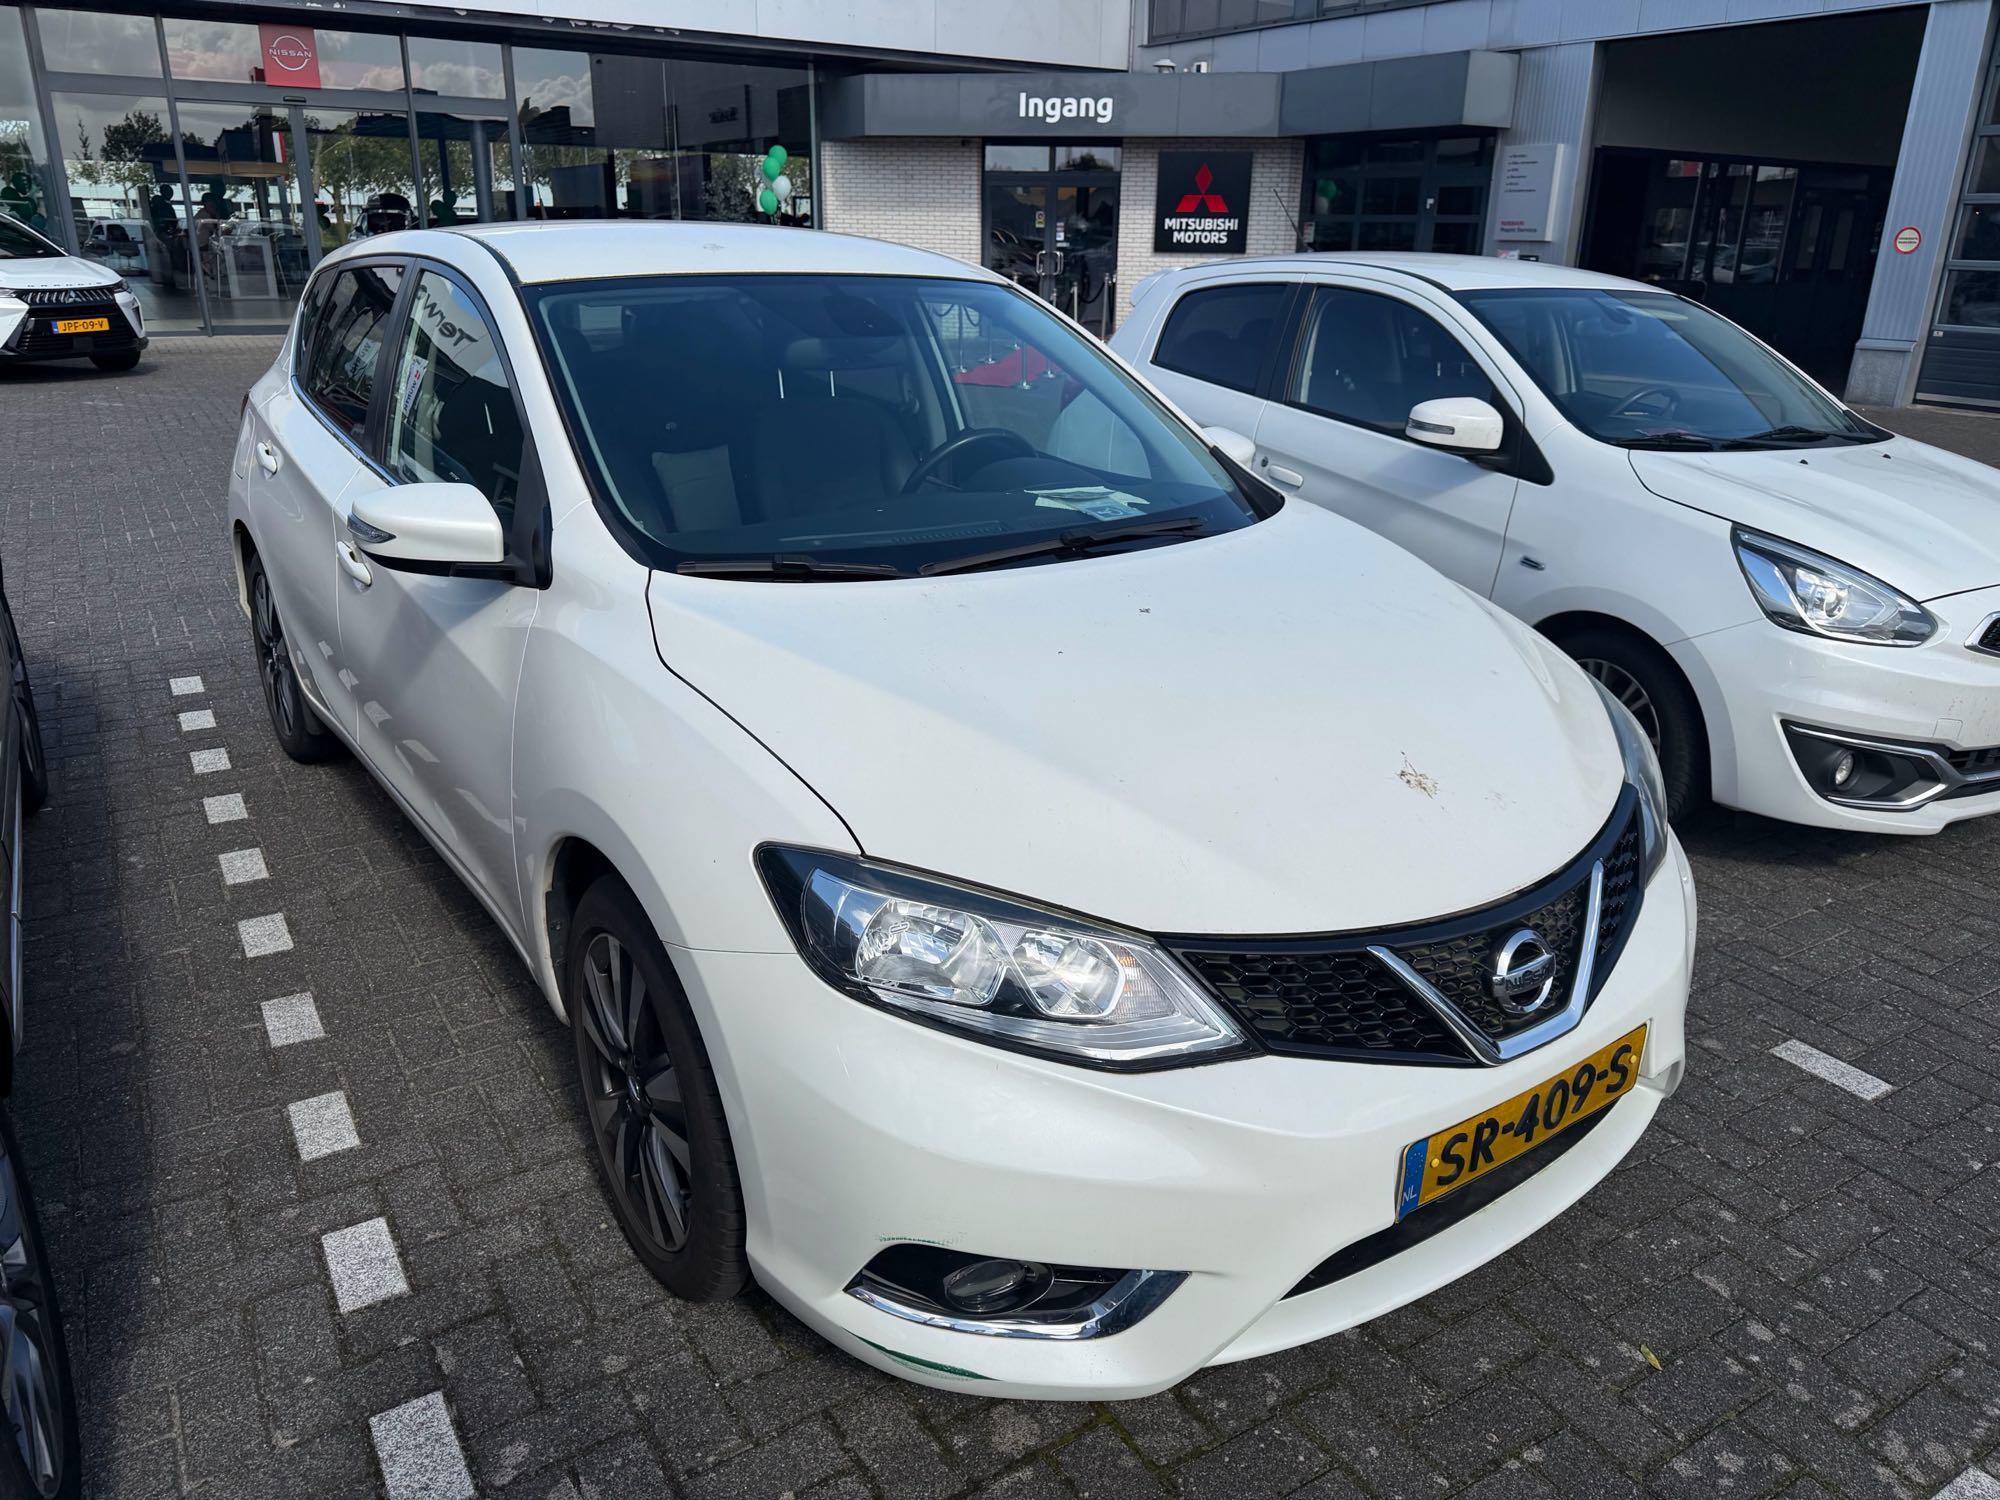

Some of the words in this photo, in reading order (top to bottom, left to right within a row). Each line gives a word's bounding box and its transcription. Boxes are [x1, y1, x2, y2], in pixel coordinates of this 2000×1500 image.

[269, 48, 311, 58] NISSAN
[1019, 92, 1114, 124] Ingang
[1164, 217, 1239, 231] MITSUBISHI
[1172, 231, 1228, 244] MOTORS
[62, 321, 104, 331] JPF-09-V
[1436, 1043, 1633, 1186] SR-409-S
[1401, 1184, 1418, 1206] NL
